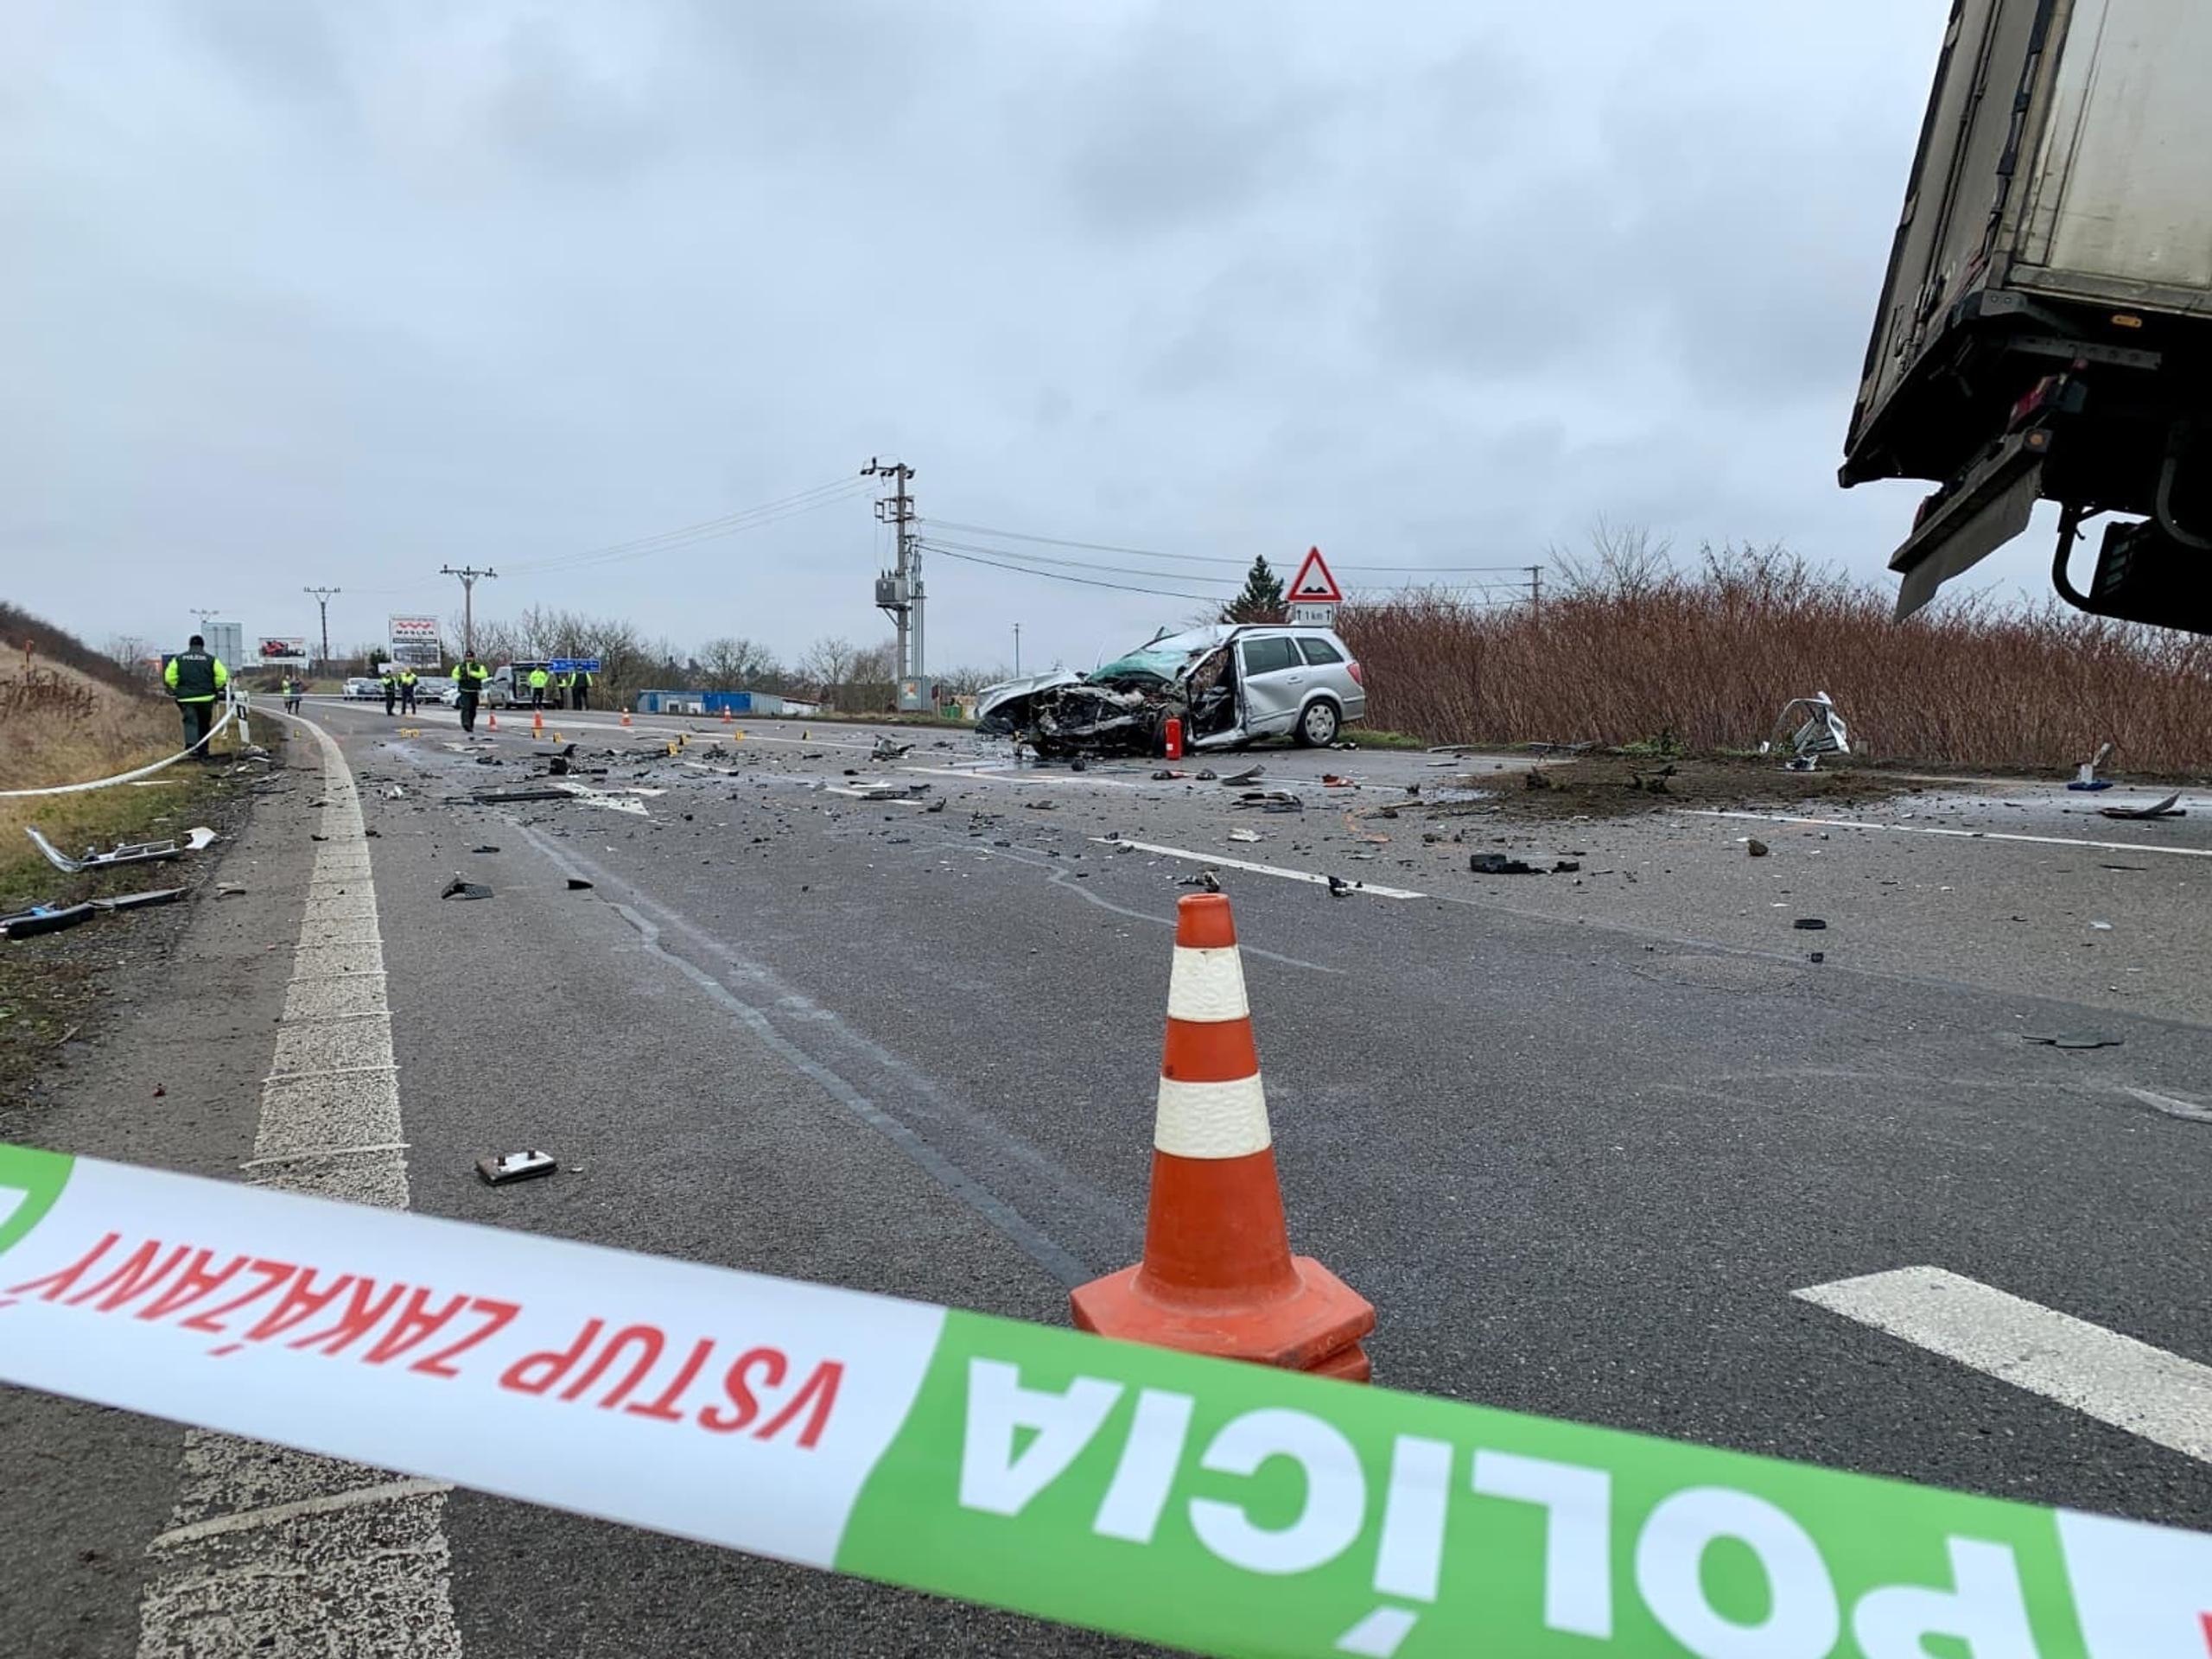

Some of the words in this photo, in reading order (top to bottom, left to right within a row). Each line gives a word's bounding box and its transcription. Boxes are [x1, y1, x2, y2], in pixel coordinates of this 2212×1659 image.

[1311, 611, 1323, 620] km
[0, 1232, 520, 1377] ZAKÁZANÝ
[500, 1318, 844, 1447] VSTUP
[958, 1356, 2042, 1659] POLÍCIA
